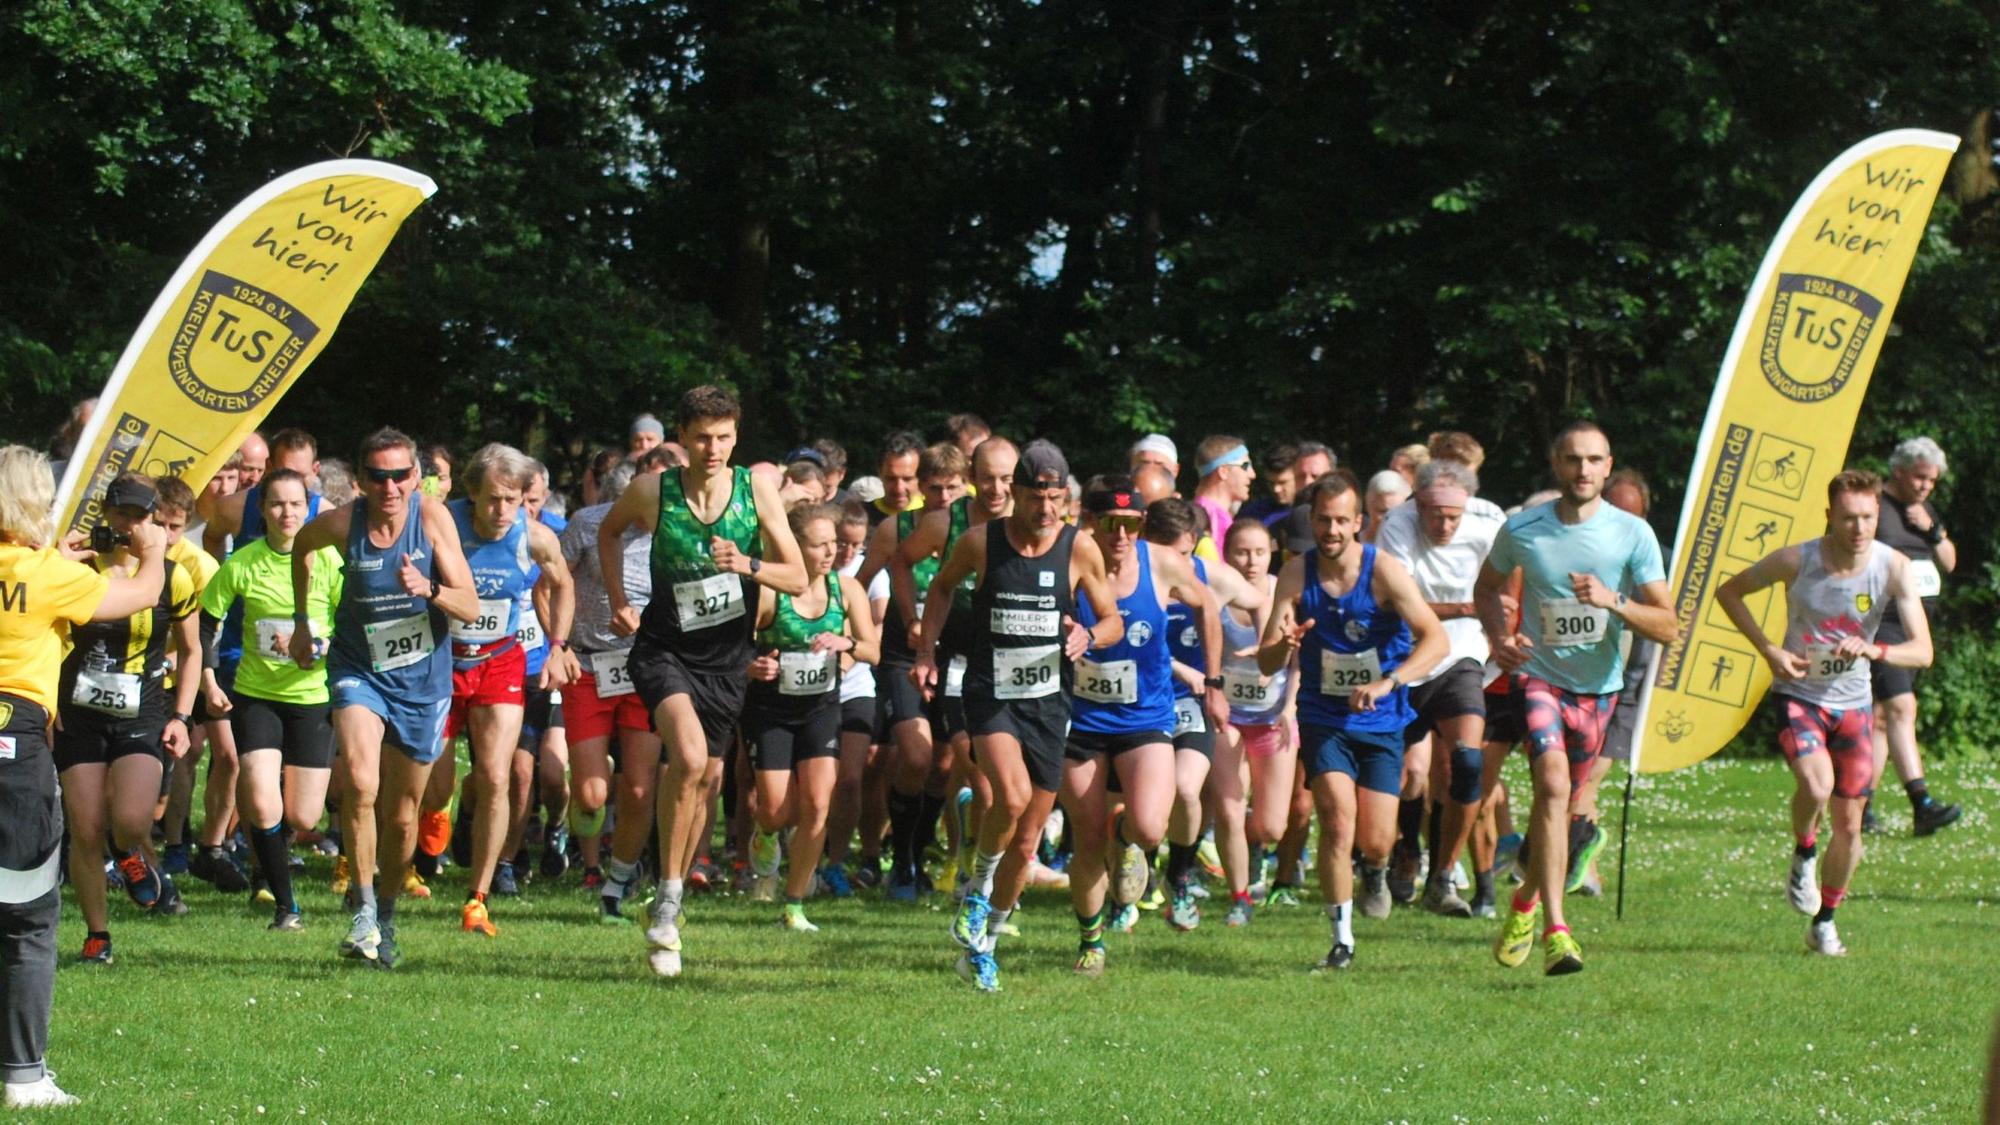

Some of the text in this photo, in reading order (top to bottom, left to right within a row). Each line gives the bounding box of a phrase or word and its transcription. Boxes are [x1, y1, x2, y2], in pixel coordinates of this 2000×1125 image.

[1865, 162, 1925, 195] Wir
[323, 183, 389, 223] Wir
[1847, 195, 1902, 225] von
[296, 211, 356, 252] von
[1813, 219, 1893, 259] hier!
[251, 226, 340, 282] hier!
[1804, 279, 1835, 297] 1924
[232, 285, 293, 324] 1924 e.V.
[210, 308, 275, 364] TuS
[1794, 306, 1847, 350] TuS
[1659, 426, 1748, 687] www.kreuzweingarten.de
[693, 591, 731, 617] 327
[515, 627, 536, 643] 98
[1555, 616, 1596, 635] 300
[385, 631, 424, 658] 297
[609, 665, 631, 684] 33
[794, 667, 828, 687] 305
[1012, 665, 1051, 686] 350
[1334, 669, 1371, 687] 329
[1820, 658, 1857, 676] 302
[88, 687, 127, 710] 253
[1087, 678, 1123, 695] 281
[1232, 683, 1266, 700] 335
